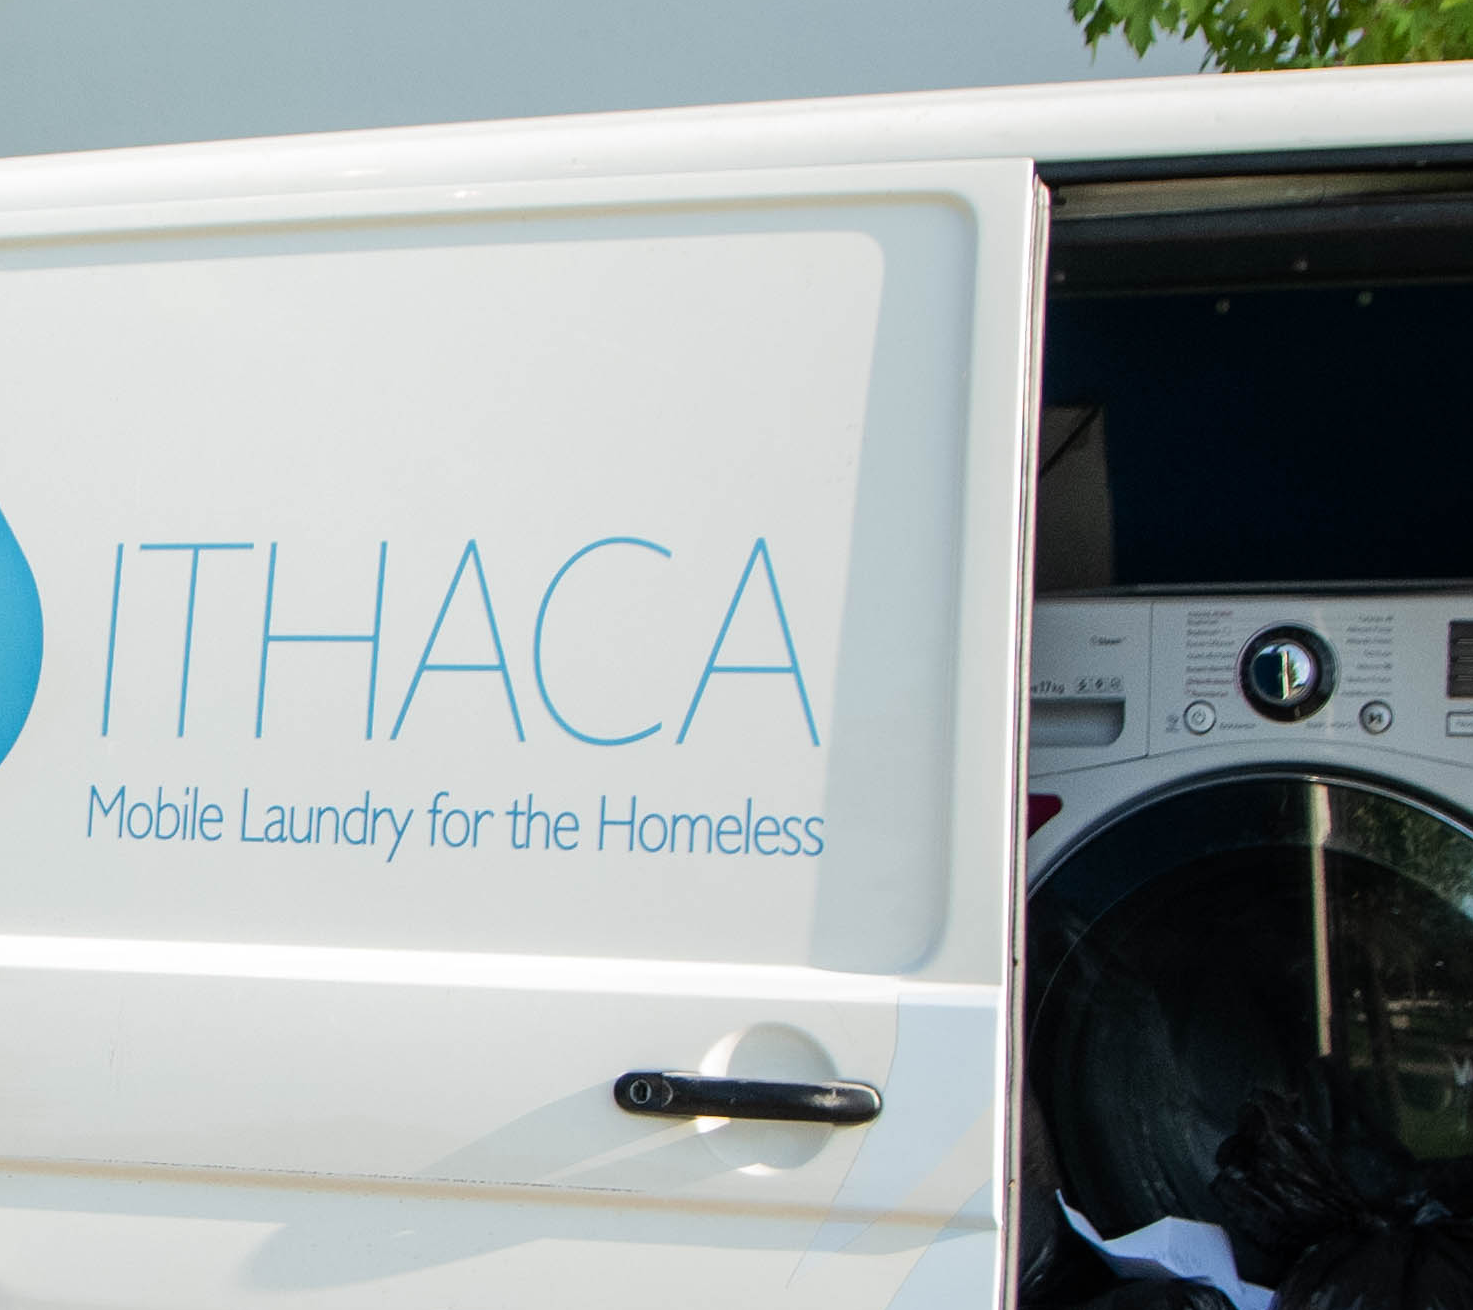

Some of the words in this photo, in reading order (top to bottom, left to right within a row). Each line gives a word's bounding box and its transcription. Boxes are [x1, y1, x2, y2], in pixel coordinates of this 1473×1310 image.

[101, 535, 821, 748] ITHACA
[86, 784, 224, 842] Mobile
[240, 787, 413, 863] Laundry
[428, 790, 495, 850] for
[505, 793, 580, 851] the
[598, 794, 825, 858] Homeless
